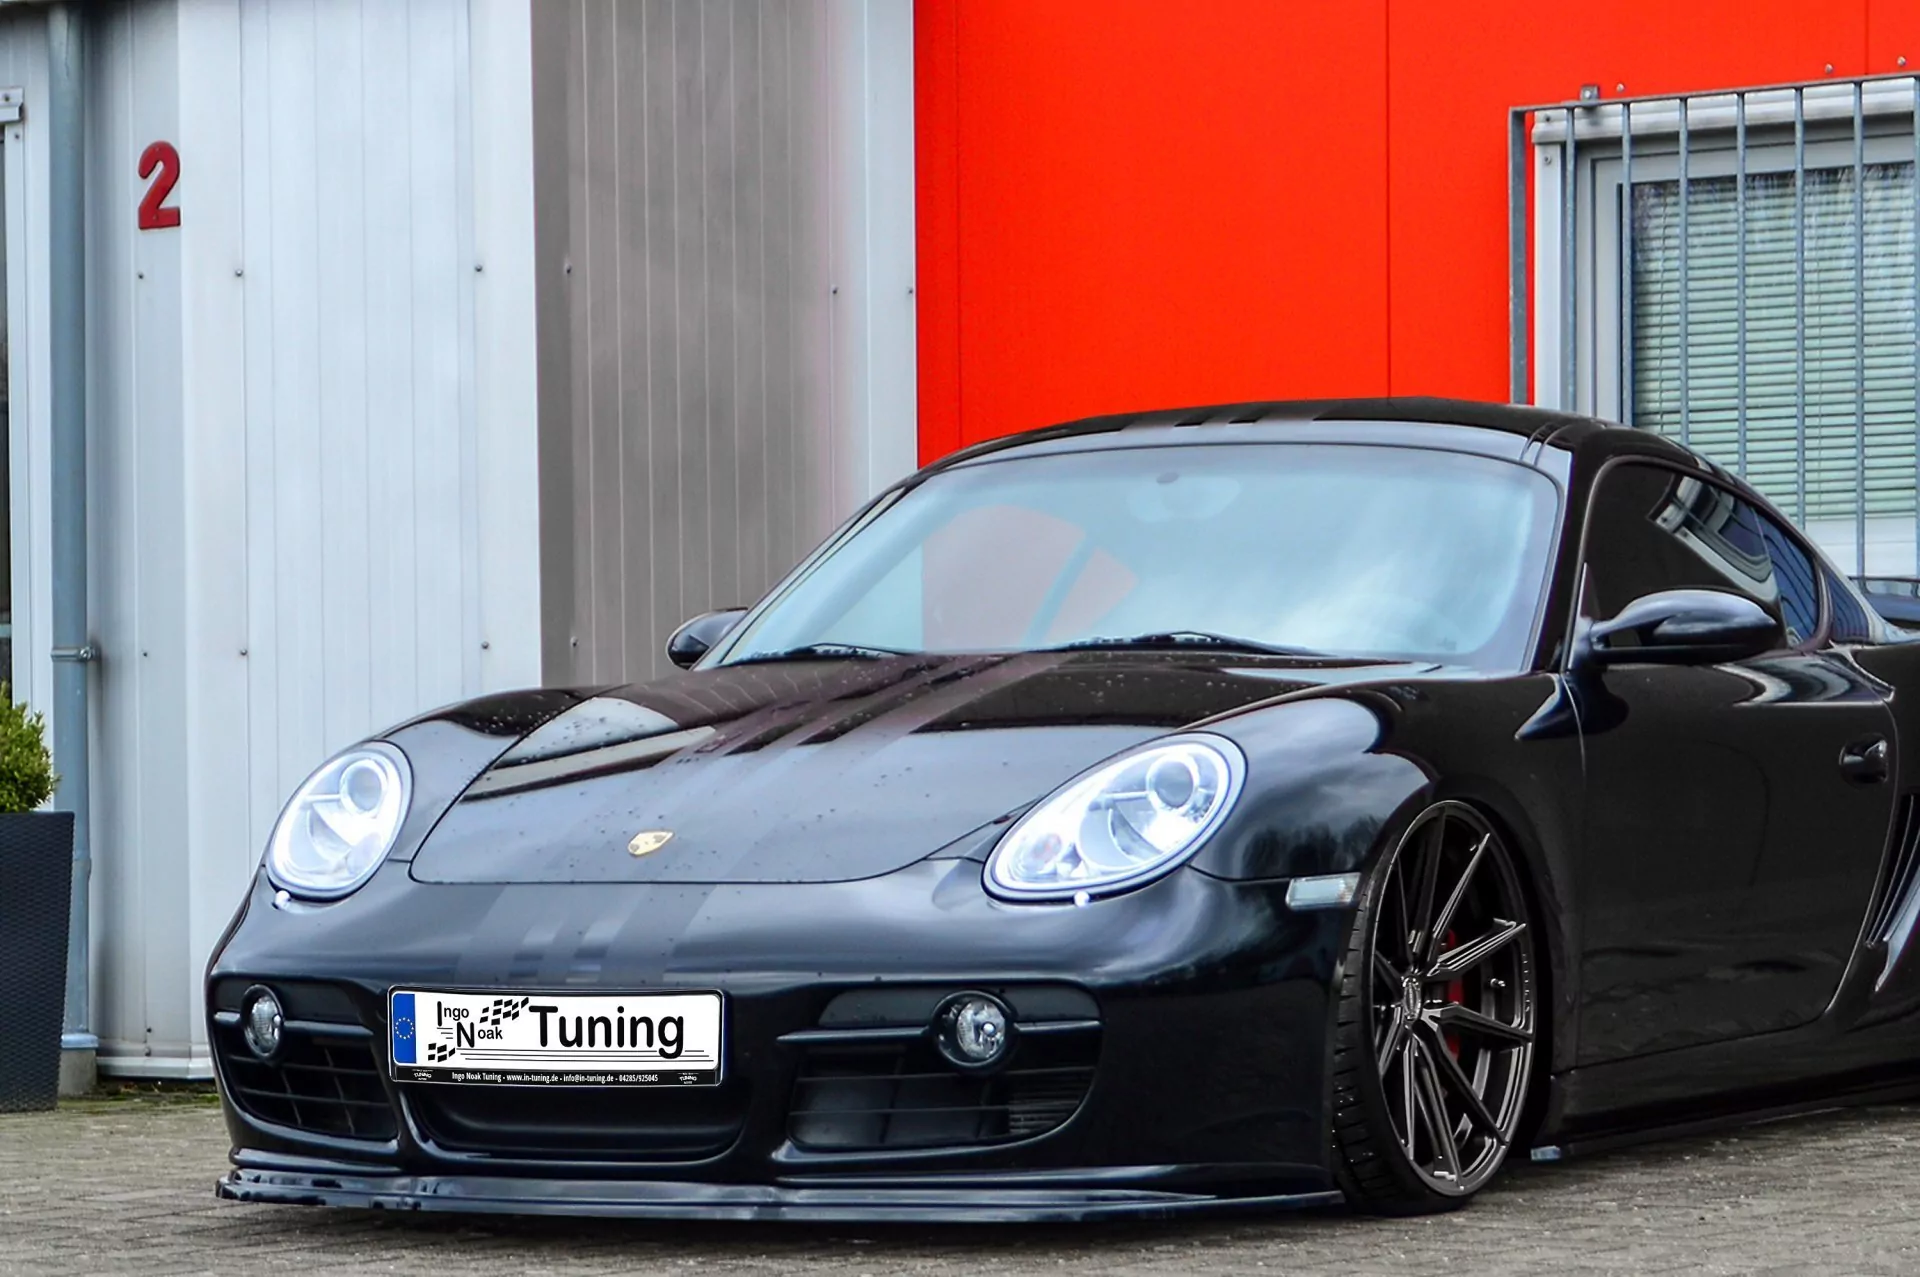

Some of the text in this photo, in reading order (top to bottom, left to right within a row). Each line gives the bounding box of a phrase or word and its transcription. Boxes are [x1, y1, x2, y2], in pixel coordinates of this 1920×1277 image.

[138, 140, 181, 230] 2
[437, 1001, 470, 1027] Ingo
[456, 1021, 503, 1048] Noak
[528, 1005, 685, 1060] Tuning
[451, 1071, 465, 1082] Ingo
[466, 1072, 481, 1081] Noak
[482, 1072, 502, 1083] Tuning
[506, 1073, 558, 1084] www.in-tuning.de
[563, 1073, 614, 1084] info@in-tuning.de
